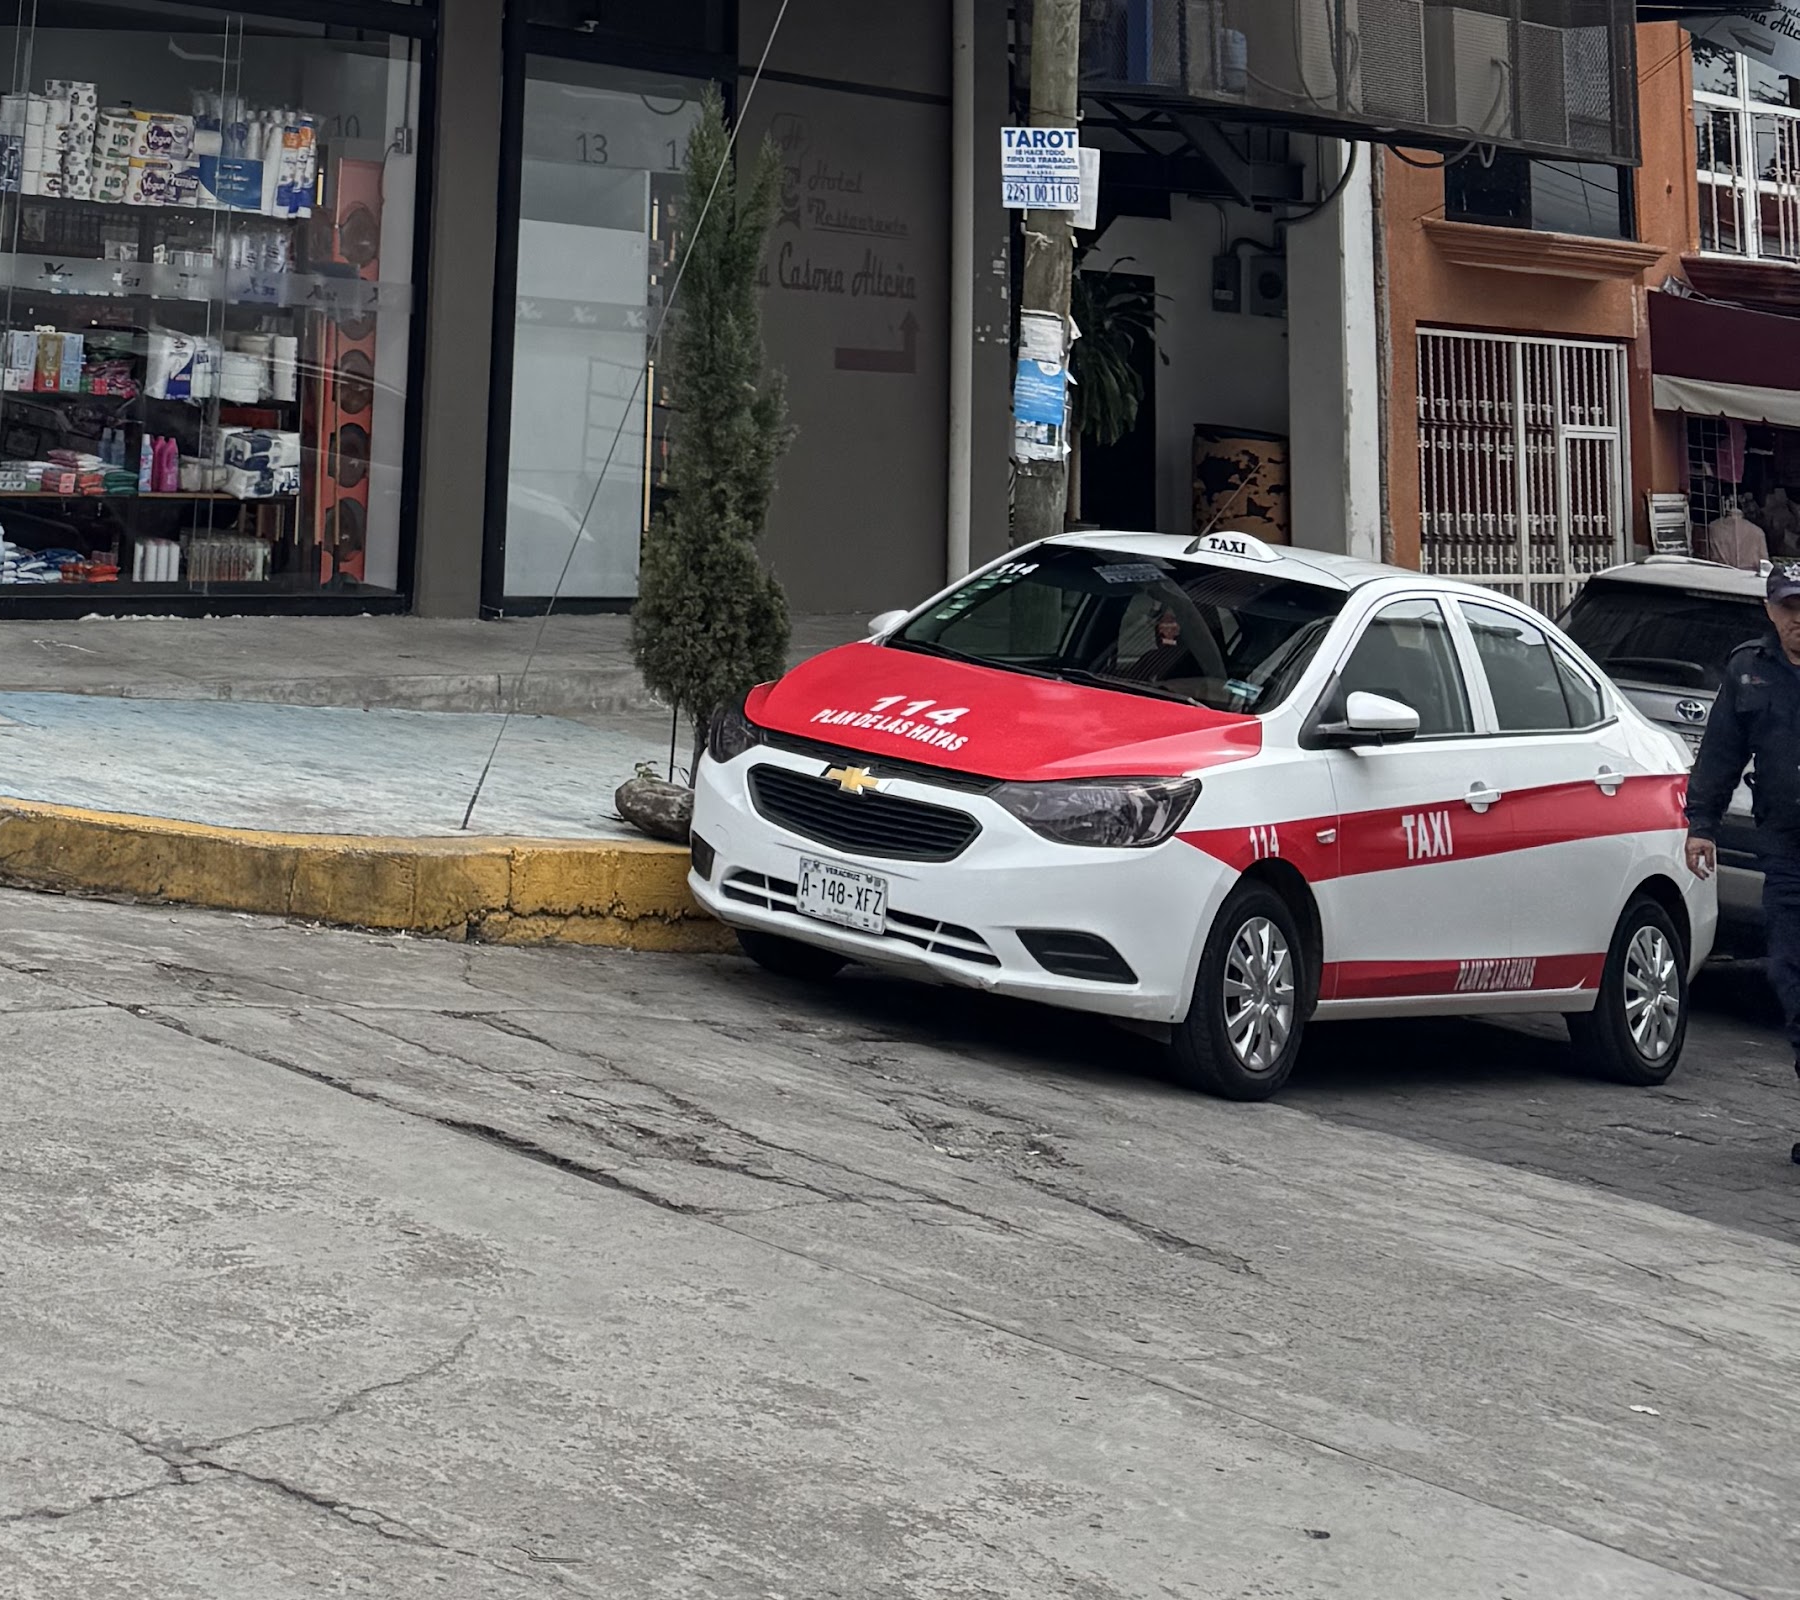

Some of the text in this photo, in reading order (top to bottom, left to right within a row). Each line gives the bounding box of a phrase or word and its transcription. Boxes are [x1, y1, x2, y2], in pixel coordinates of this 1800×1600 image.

[147, 129, 172, 146] Vogue
[576, 133, 608, 165] 13
[1003, 129, 1077, 149] TAROT
[142, 177, 166, 192] Vogue
[807, 159, 865, 194] Hotel
[1034, 184, 1048, 202] 00
[1051, 185, 1061, 202] 11
[1065, 185, 1079, 203] 03
[778, 240, 845, 294] Casona
[1209, 537, 1246, 554] TAXI
[869, 695, 971, 726] 114
[810, 708, 969, 752] PLAN DE LAS HAYAS
[1249, 825, 1280, 860] 114
[1401, 810, 1454, 860] TAXI
[825, 866, 861, 882] VERACRUZ
[801, 872, 883, 916] A-148-XFZ
